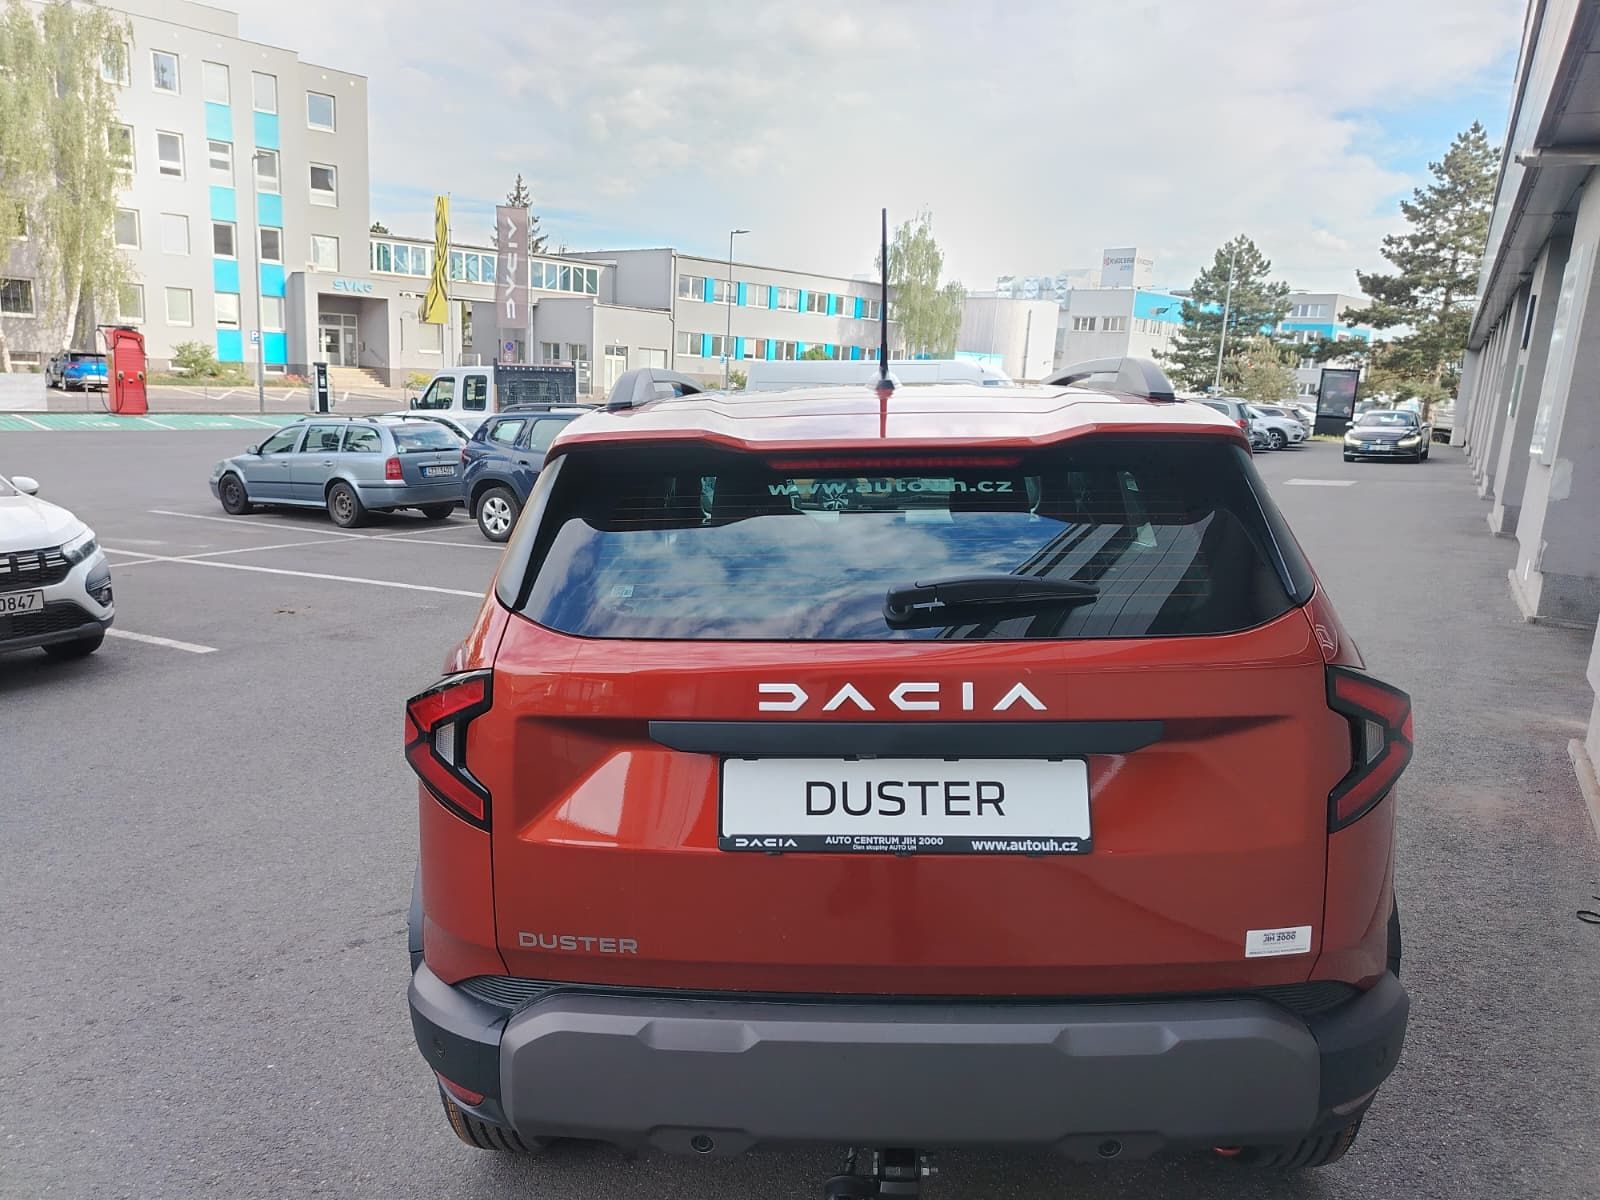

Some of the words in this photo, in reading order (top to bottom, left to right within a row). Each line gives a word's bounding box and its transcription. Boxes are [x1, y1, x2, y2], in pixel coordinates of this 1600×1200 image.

[506, 216, 518, 319] DACIA
[768, 479, 1013, 495] www.autouh.cz
[758, 682, 1048, 711] DACIA
[806, 781, 1006, 816] DUSTER
[735, 838, 798, 847] DACIA
[825, 836, 852, 844] AUTO
[854, 836, 899, 845] CENTRUM
[901, 837, 917, 845] JIH
[918, 837, 944, 846] 2000
[971, 839, 1079, 851] www.autouh.cz
[518, 931, 638, 954] DUSTER
